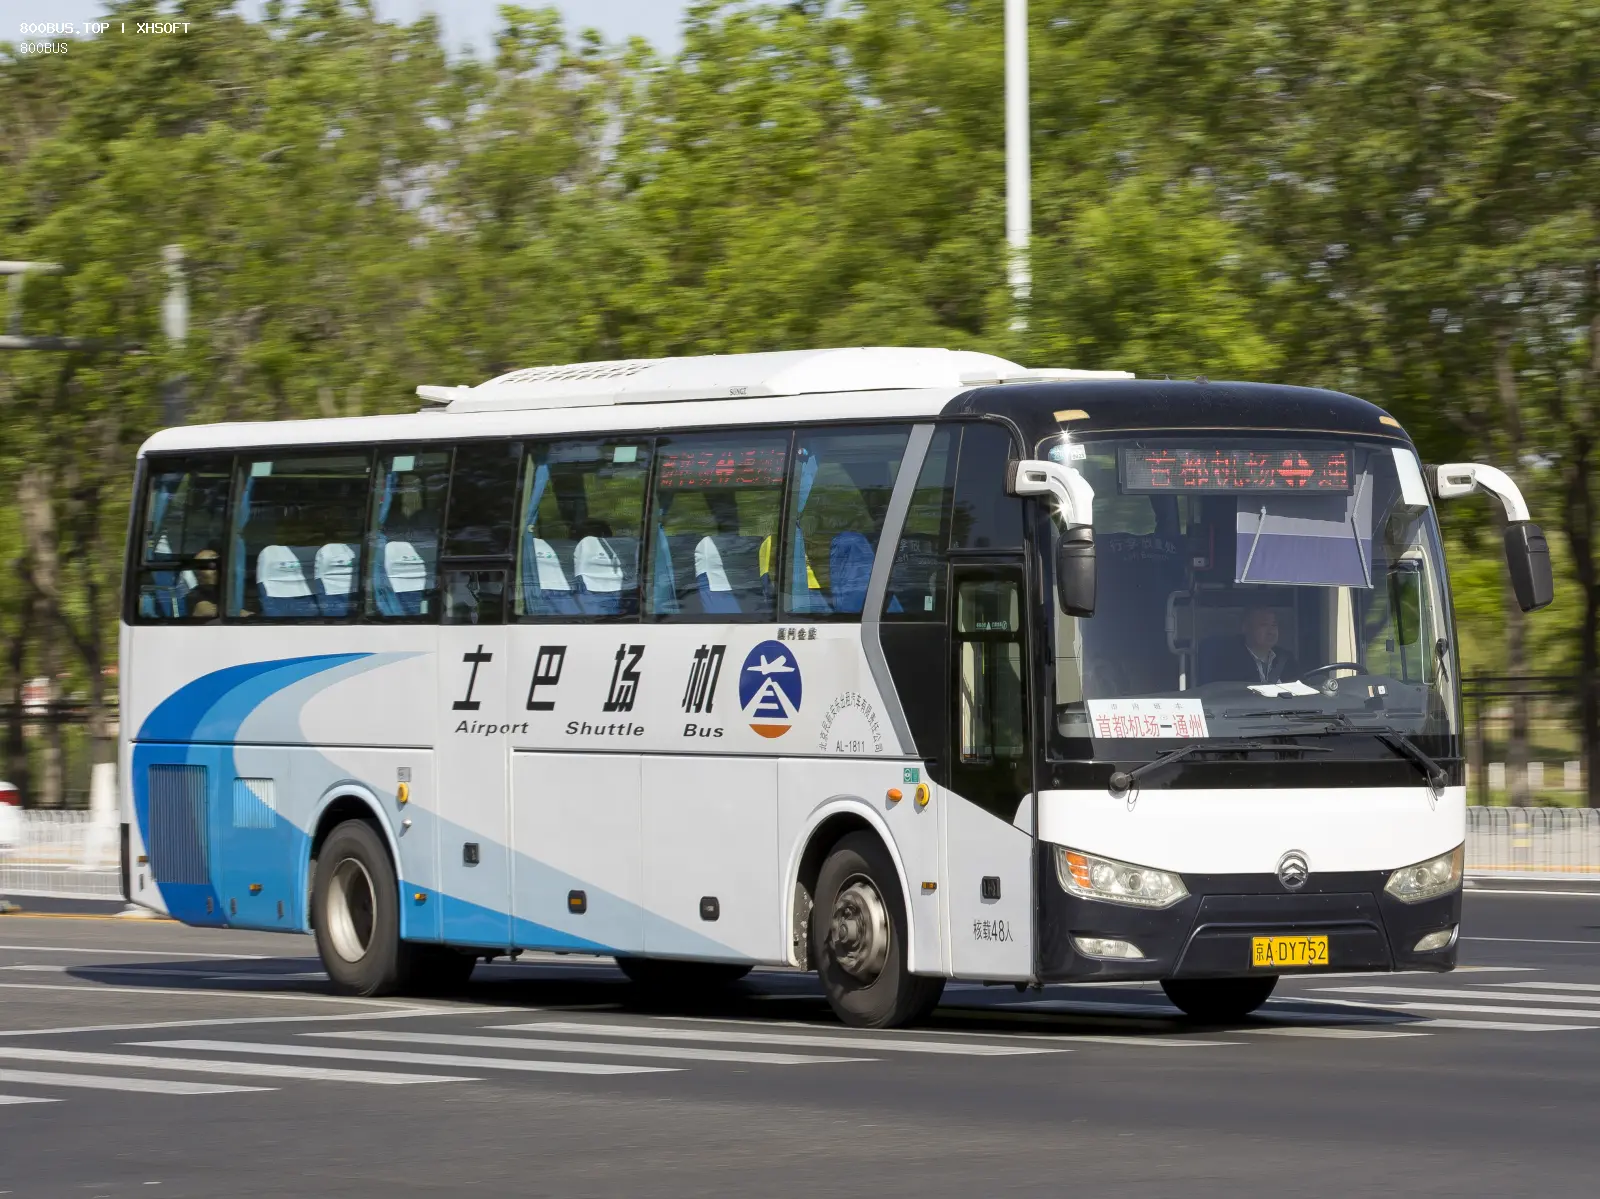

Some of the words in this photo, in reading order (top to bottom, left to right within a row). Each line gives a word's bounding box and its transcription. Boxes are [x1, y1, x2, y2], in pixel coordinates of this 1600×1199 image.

[455, 720, 529, 737] Airport
[565, 721, 645, 736] Shuttle
[683, 723, 724, 738] Bus
[836, 740, 865, 752] AL-1811
[973, 919, 1014, 942] 核载48人
